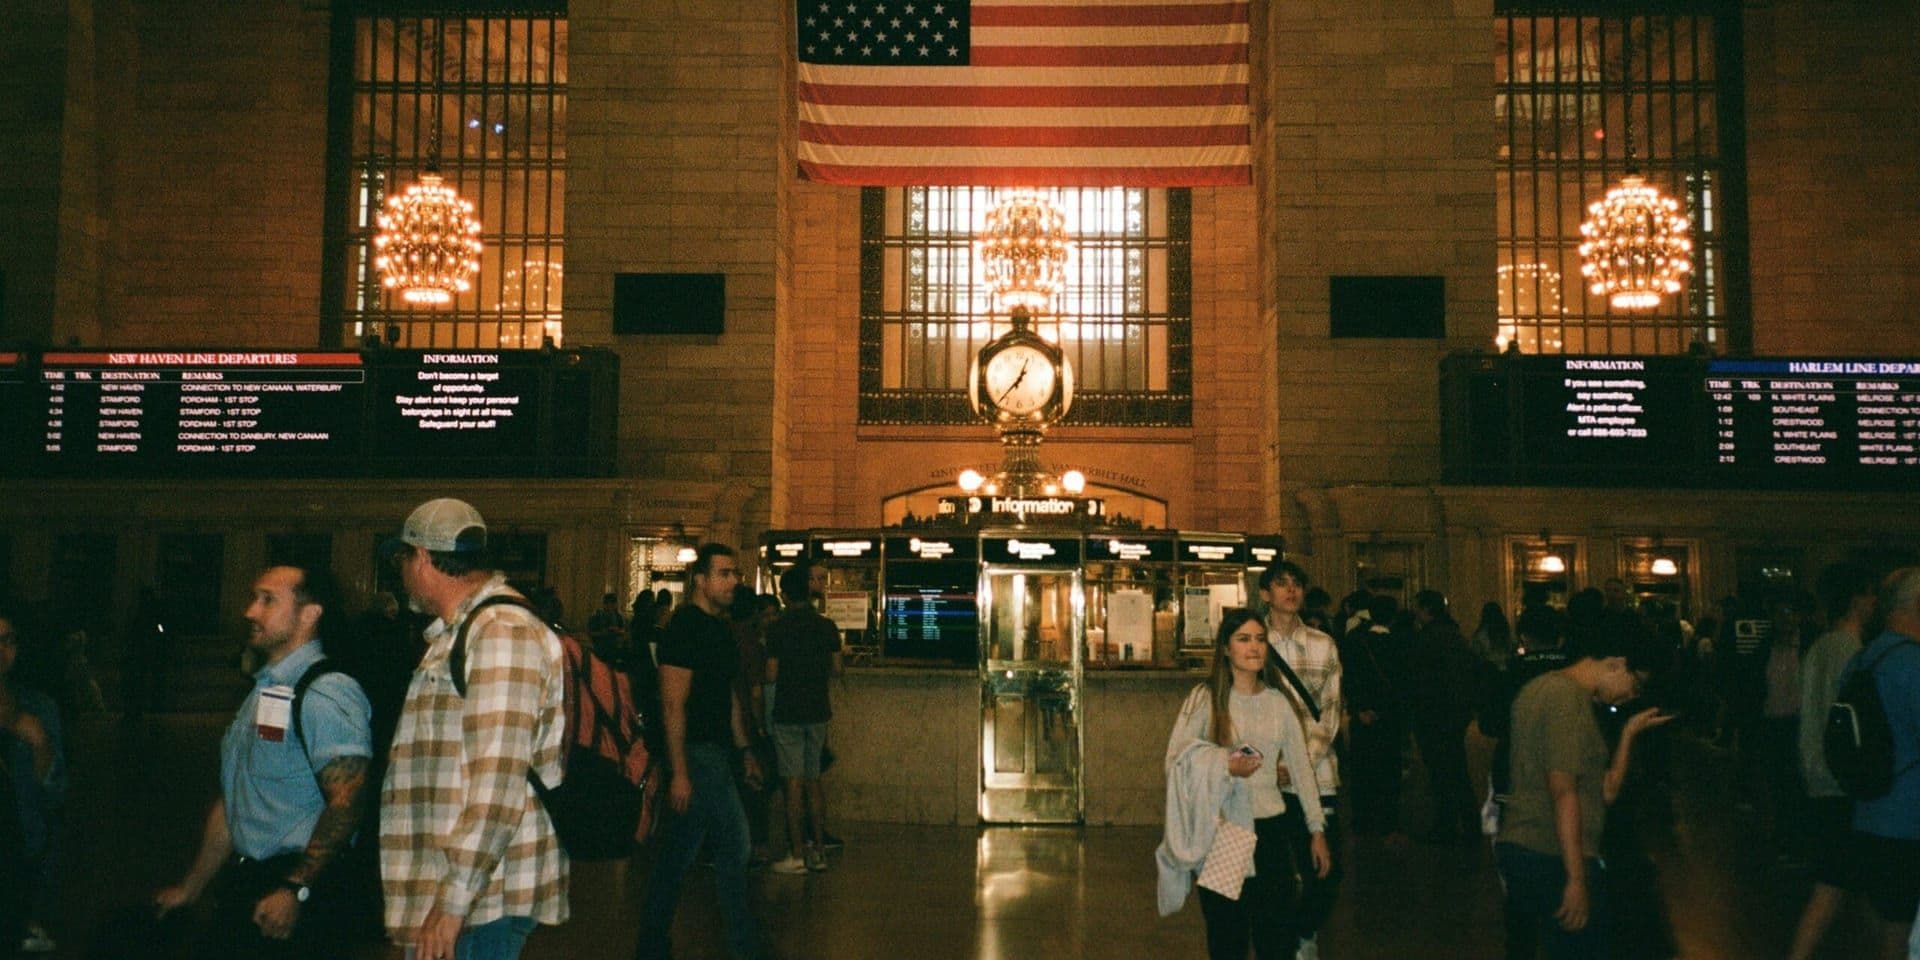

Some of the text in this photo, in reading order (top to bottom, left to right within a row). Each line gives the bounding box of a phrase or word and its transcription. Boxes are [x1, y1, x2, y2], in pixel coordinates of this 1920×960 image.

[110, 354, 297, 364] NEW HAVEN LINE DEPARTURES
[423, 354, 498, 364] INFORMATION
[1566, 360, 1644, 370] INFORMATION
[1790, 362, 1843, 373] HARLEM
[1846, 363, 1877, 373] LINE
[1741, 381, 1760, 389] TRK
[992, 497, 1074, 513] Information
